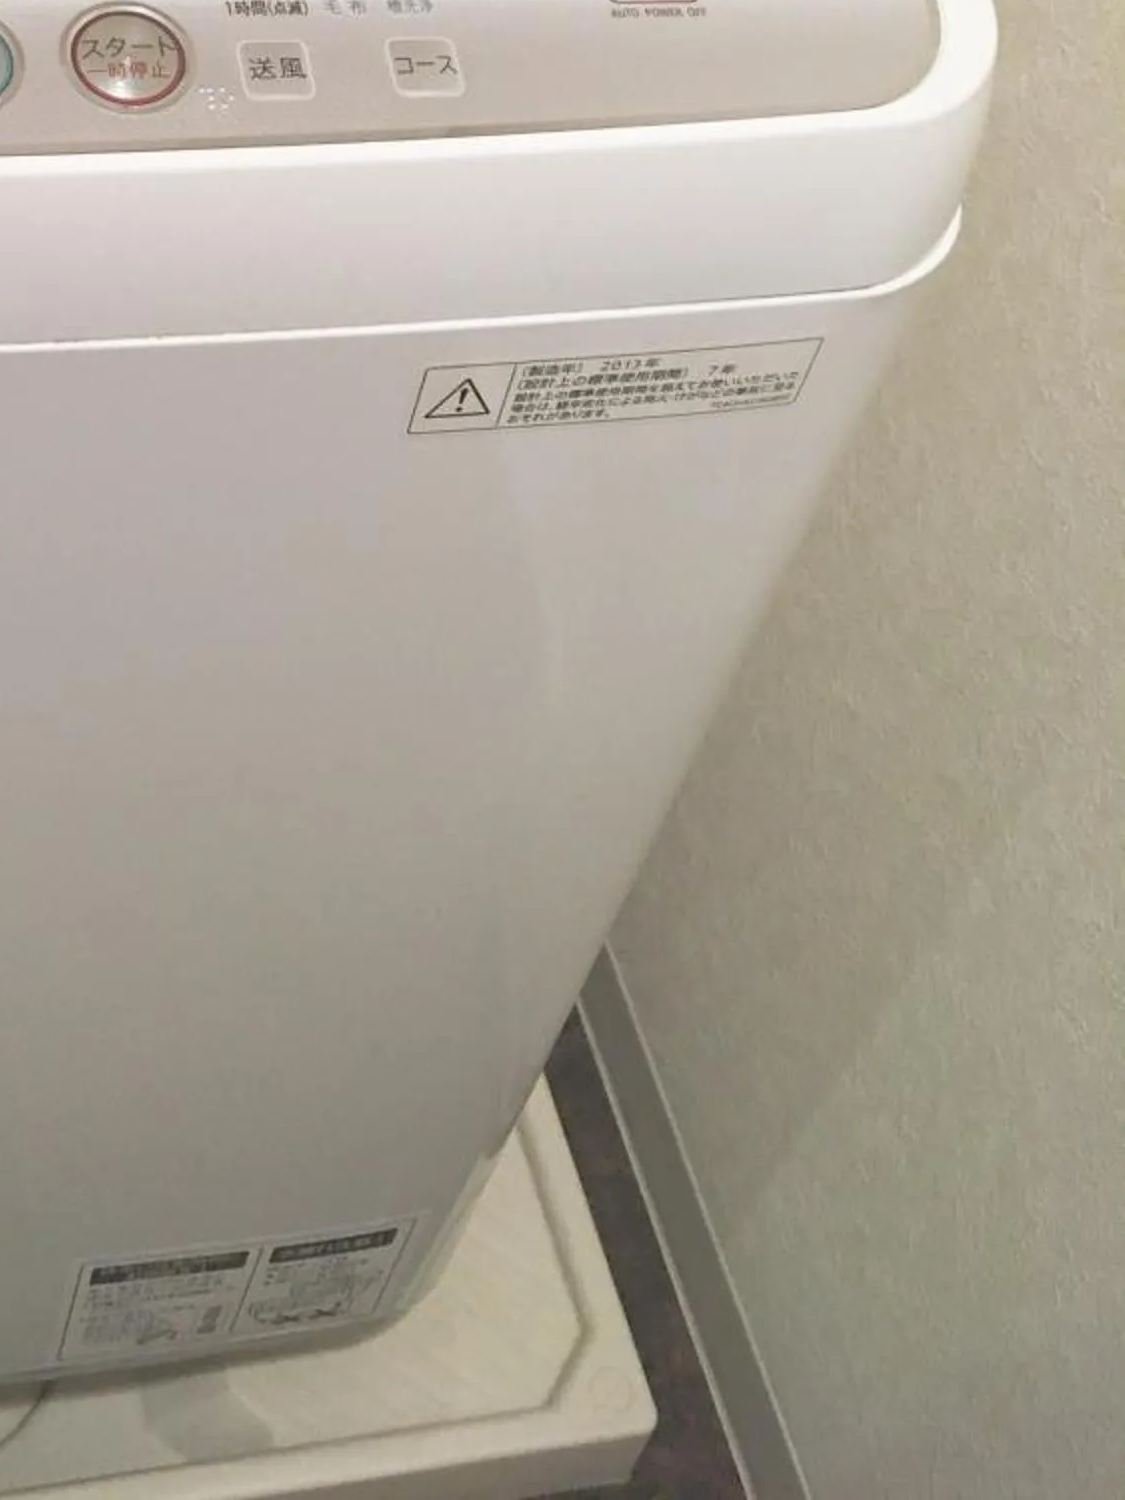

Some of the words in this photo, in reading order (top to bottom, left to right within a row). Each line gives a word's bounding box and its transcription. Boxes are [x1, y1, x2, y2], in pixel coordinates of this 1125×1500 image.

[81, 35, 178, 60] スタート
[248, 57, 307, 81] 送風
[395, 56, 459, 76] コース
